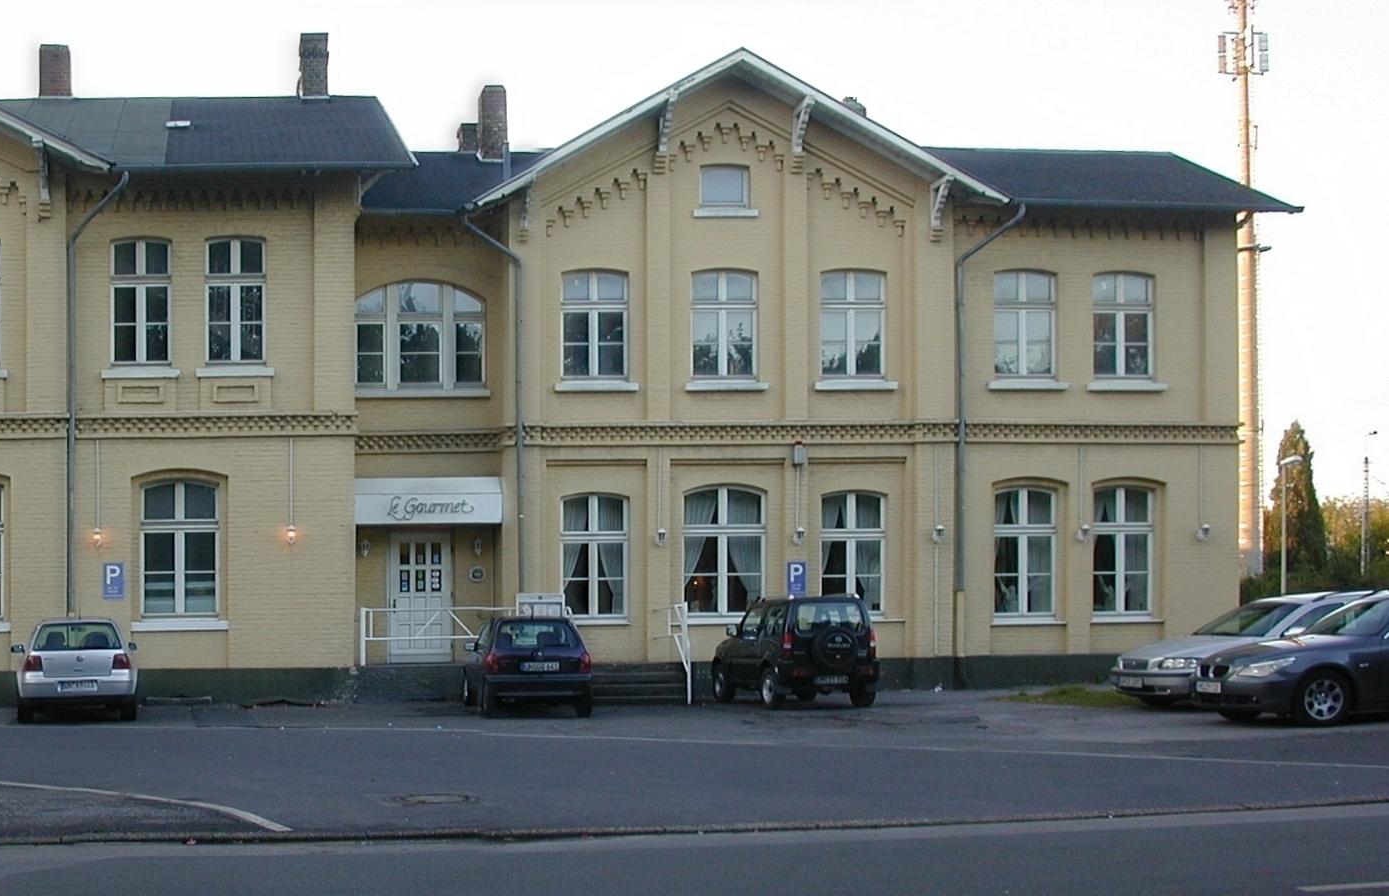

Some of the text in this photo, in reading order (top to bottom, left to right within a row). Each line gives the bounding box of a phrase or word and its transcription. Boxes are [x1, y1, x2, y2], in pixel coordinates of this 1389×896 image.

[387, 495, 474, 521] Le Gourmet
[106, 564, 121, 585] P
[790, 564, 803, 582] P
